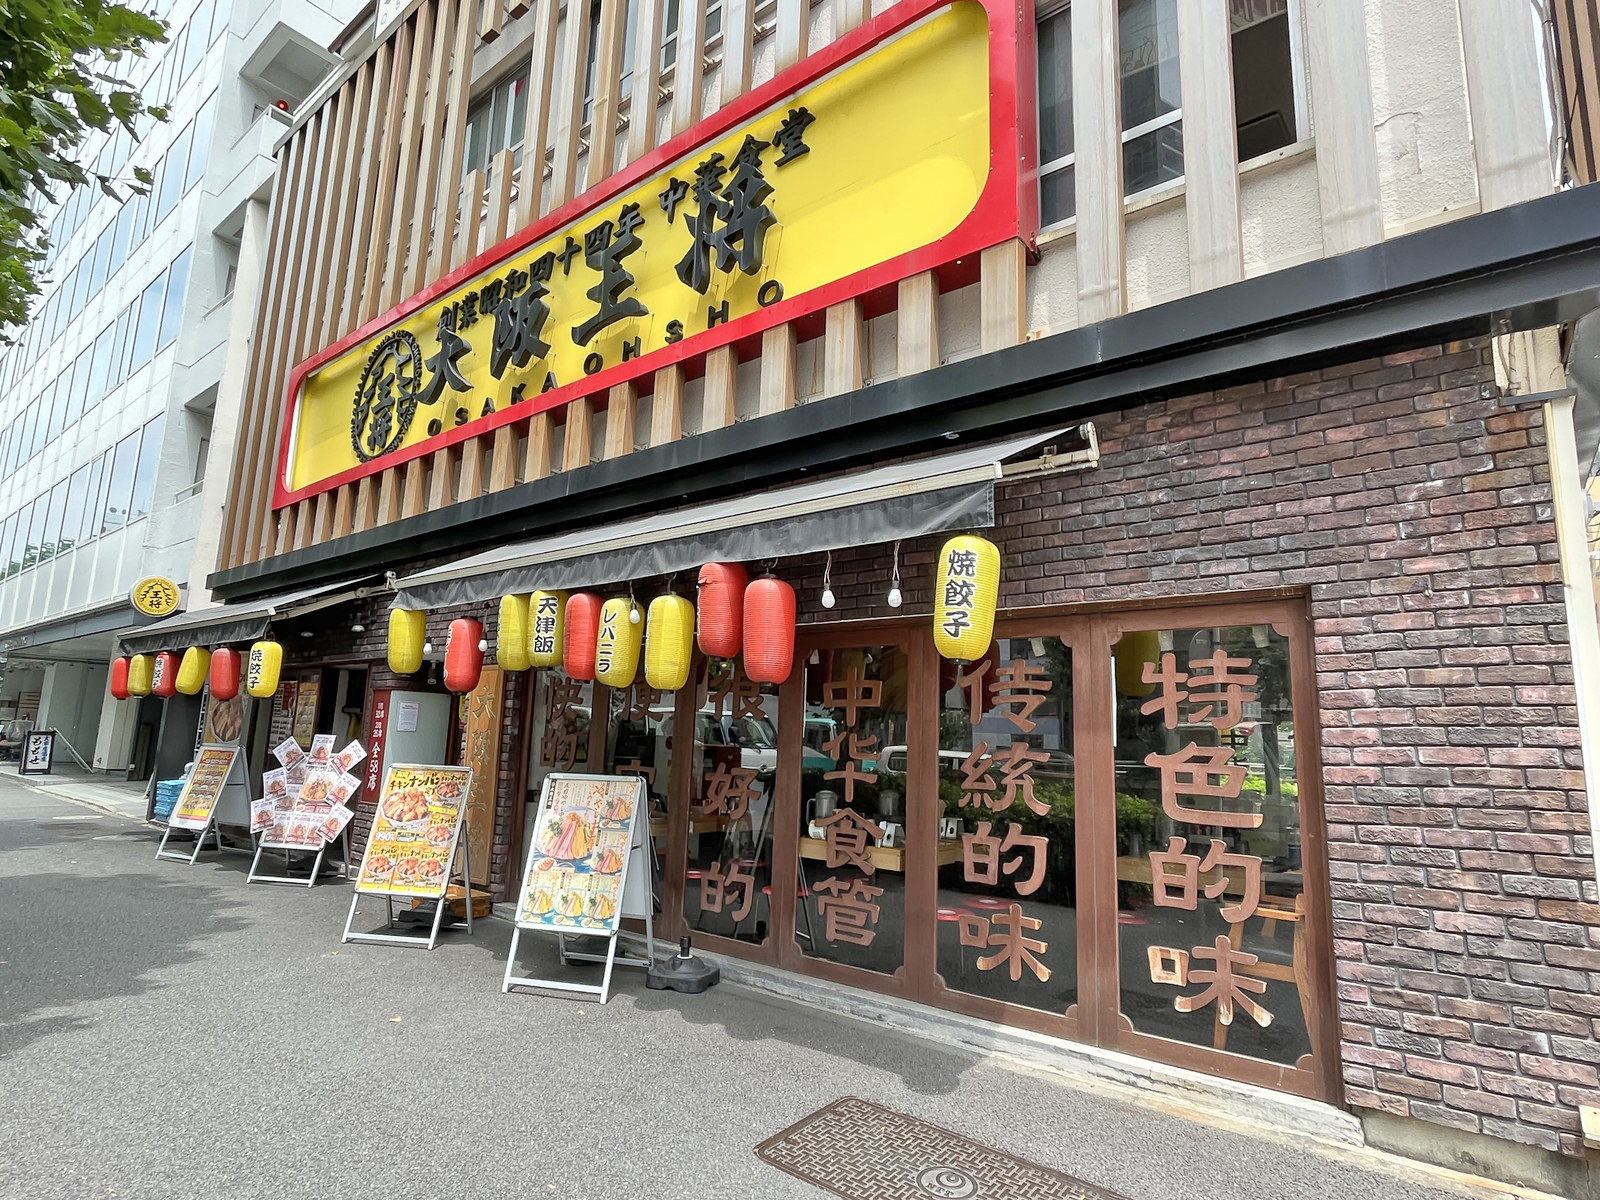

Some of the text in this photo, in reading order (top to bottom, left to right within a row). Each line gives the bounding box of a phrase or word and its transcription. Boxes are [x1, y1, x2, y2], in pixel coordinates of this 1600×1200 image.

[414, 163, 778, 406] 大阪王将
[427, 371, 558, 437] OSAKA
[583, 279, 784, 375] OHSHO
[366, 372, 396, 452] 王将
[149, 590, 163, 609] 王将
[534, 596, 558, 653] 天津飯
[943, 549, 977, 638] 焼餃子
[248, 649, 263, 689] 焼餃子
[598, 608, 617, 673] レバニラ
[1140, 649, 1275, 1028] 特色的味
[926, 1182, 954, 1197] NTT
